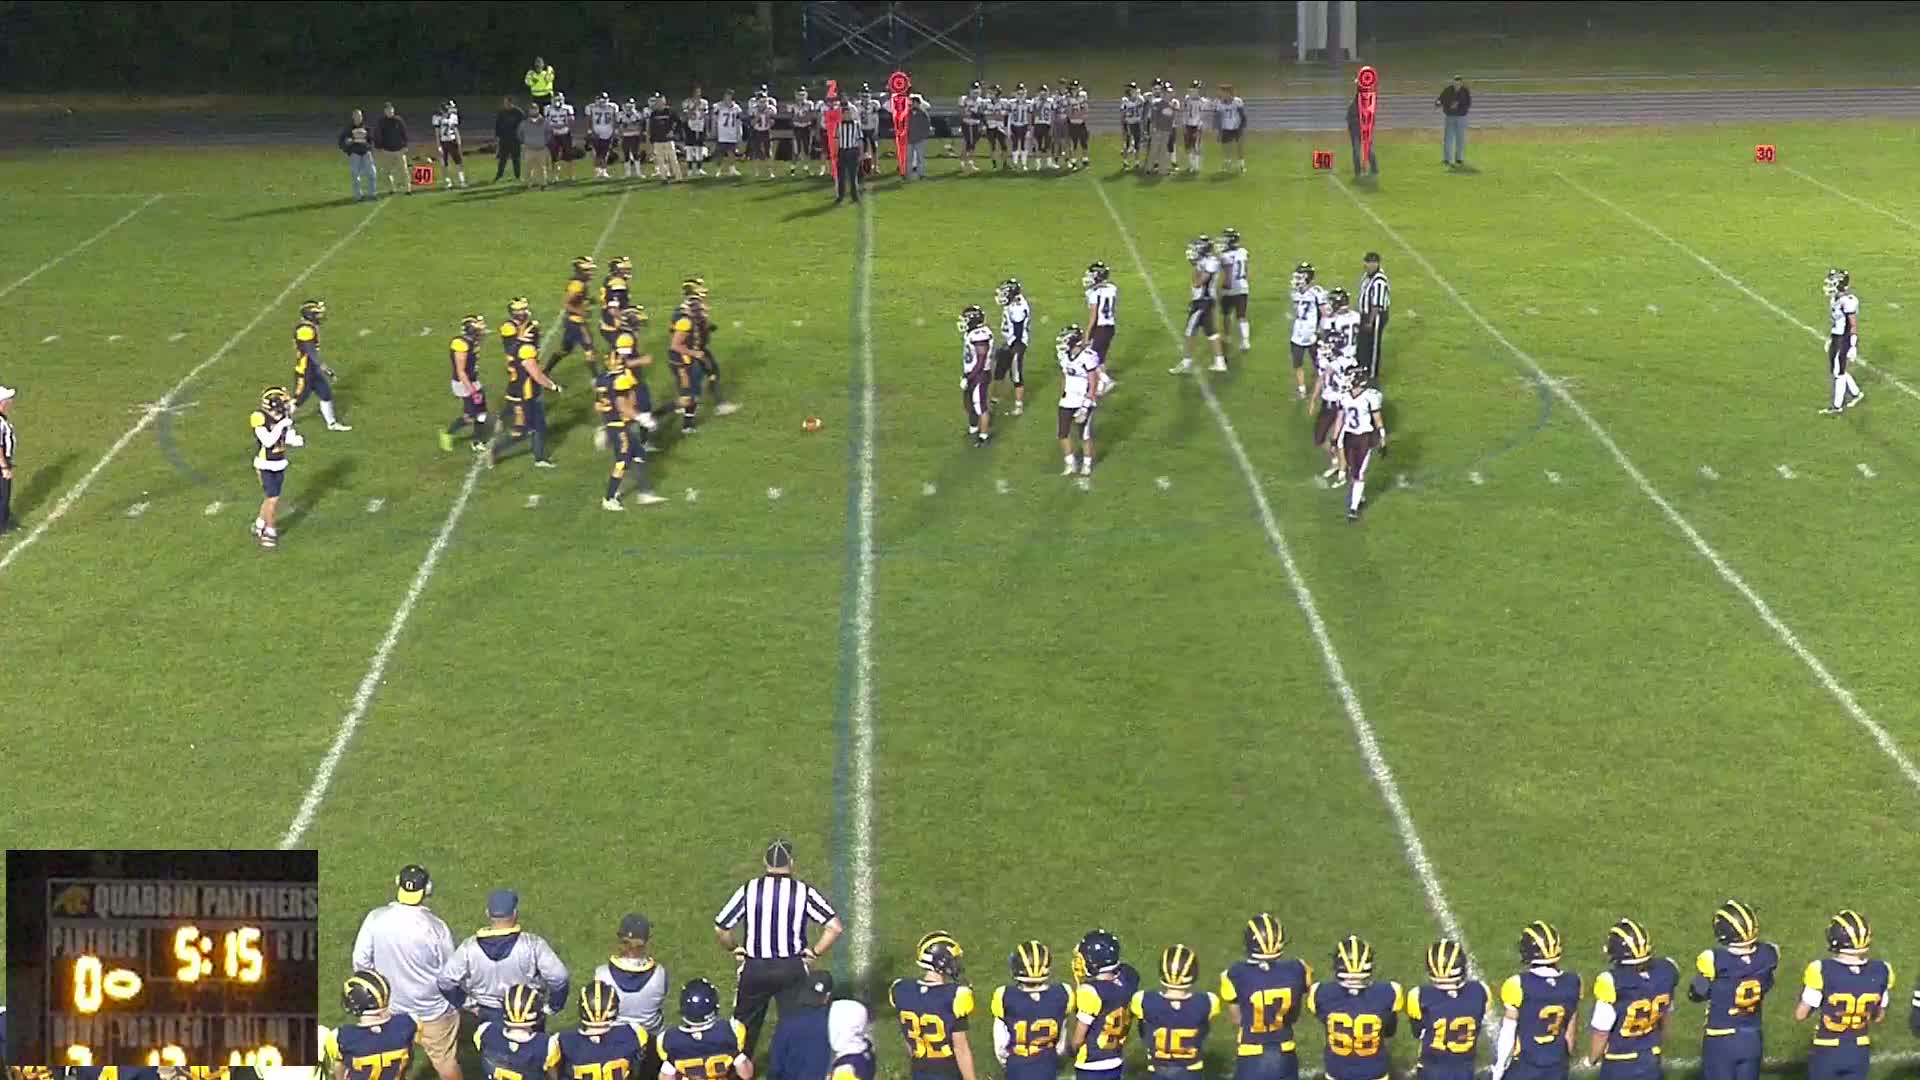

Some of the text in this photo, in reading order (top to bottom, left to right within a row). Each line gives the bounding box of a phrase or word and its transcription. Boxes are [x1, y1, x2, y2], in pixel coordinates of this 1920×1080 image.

[1316, 151, 1331, 169] 40
[1757, 146, 1773, 161] 30
[415, 167, 431, 185] 40
[1347, 406, 1360, 430] 3
[1250, 987, 1292, 1033] 17
[1728, 979, 1762, 1016] 9
[900, 1010, 953, 1059] 32
[1013, 1018, 1059, 1057] 12
[1327, 1012, 1382, 1057] 68
[1429, 1016, 1476, 1053] 13
[1533, 1004, 1566, 1044] 3
[1153, 1027, 1200, 1059] 15
[352, 1048, 410, 1080] 77
